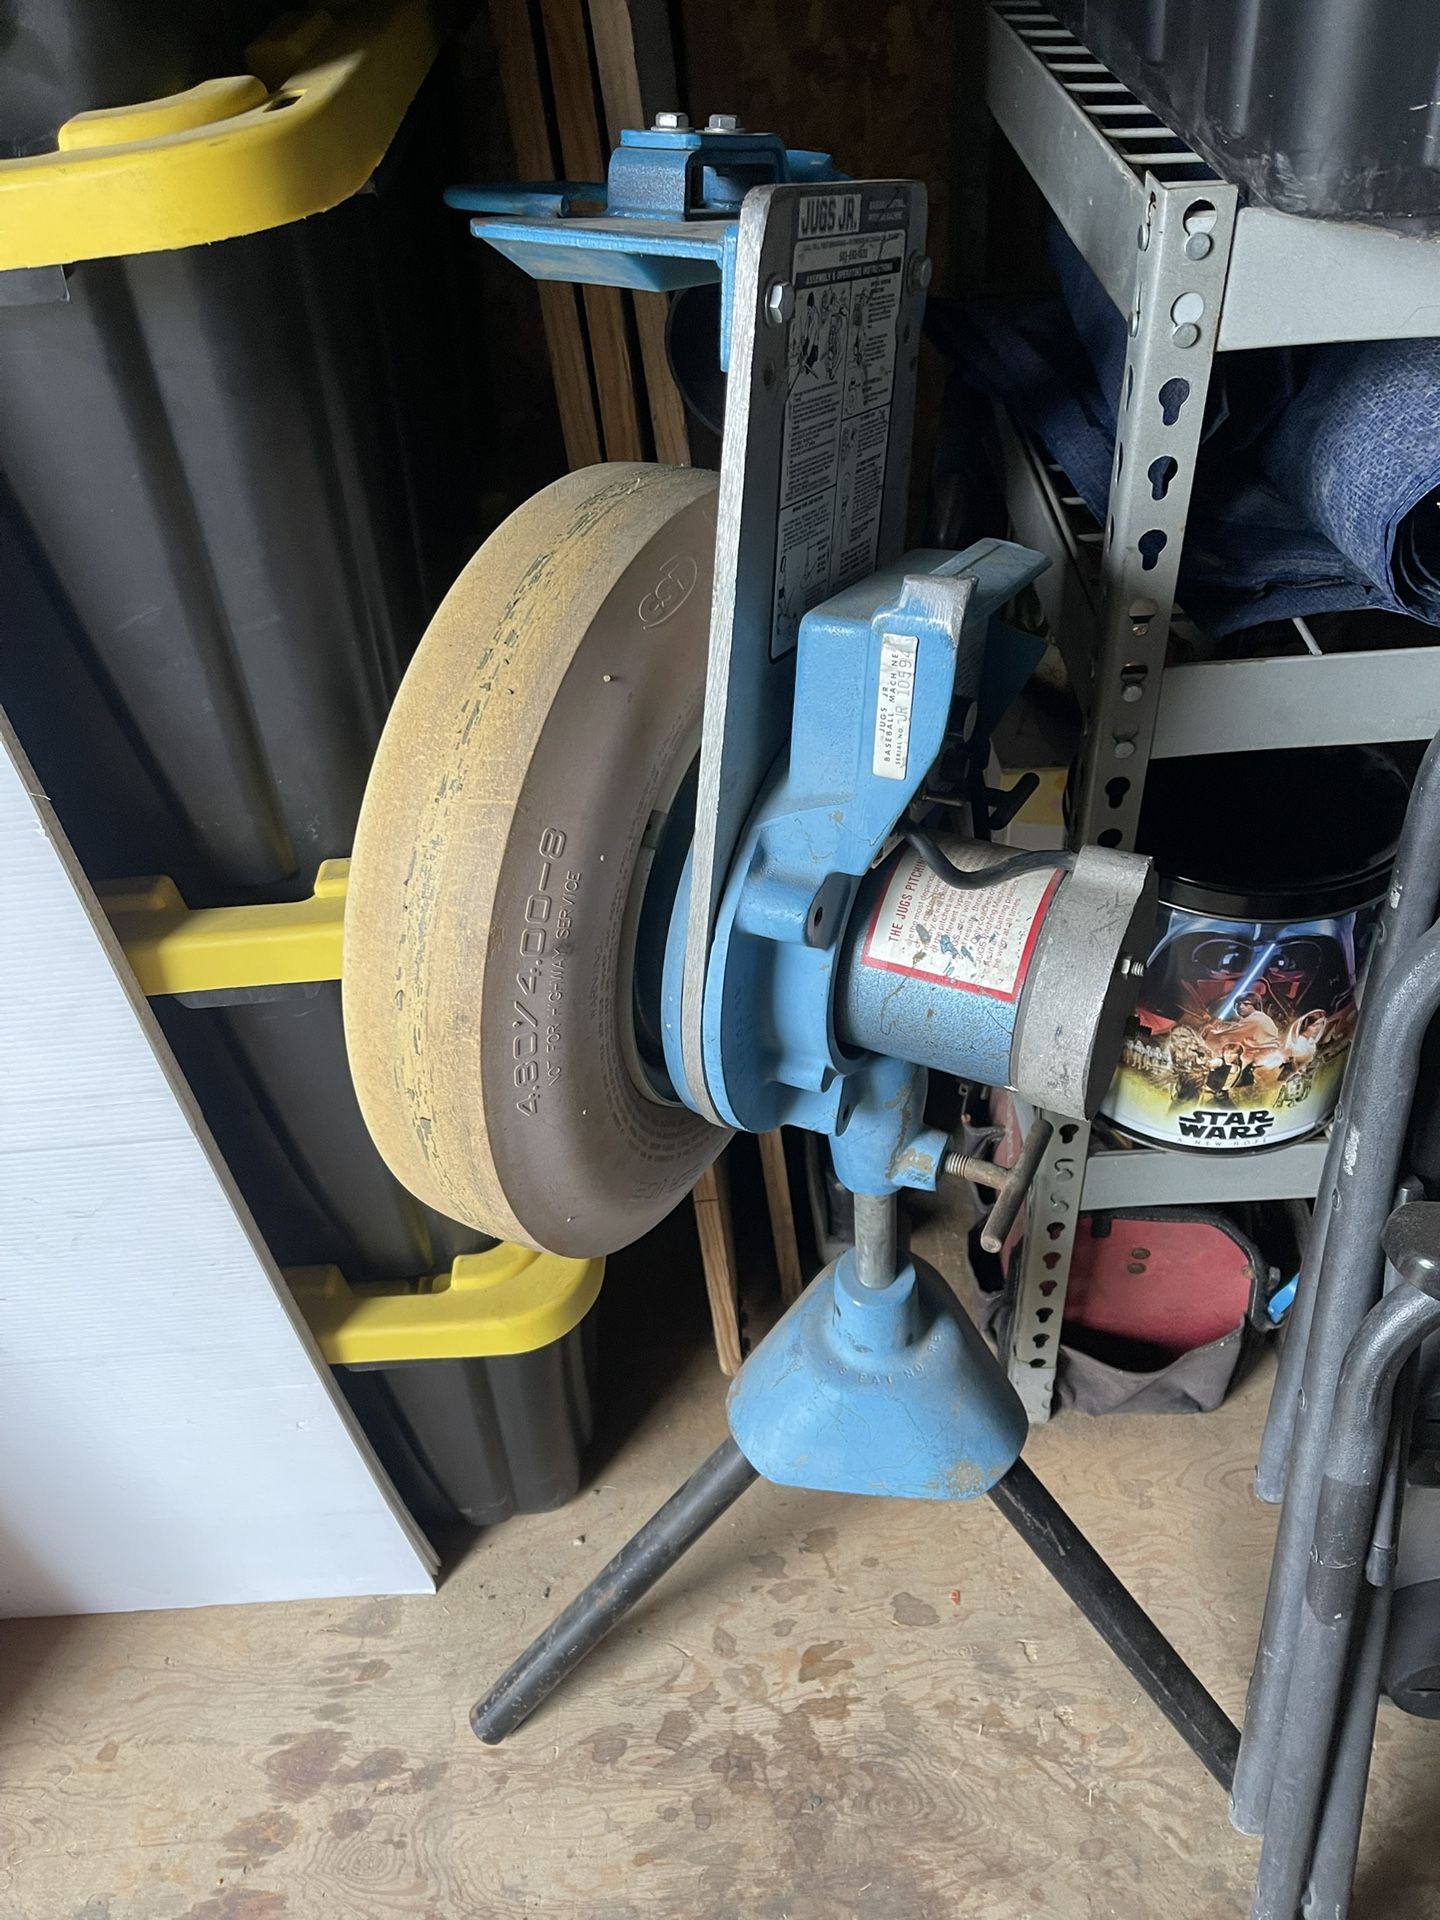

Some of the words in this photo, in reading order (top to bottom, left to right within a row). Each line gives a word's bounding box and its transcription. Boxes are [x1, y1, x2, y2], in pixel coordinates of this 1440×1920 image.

[801, 196, 836, 235] JUGS
[838, 196, 858, 232] JR.
[888, 653, 899, 703] MACHNE
[879, 707, 888, 733] JUGS
[884, 712, 894, 762] BASEBALL
[895, 741, 903, 765] SERIAL
[555, 869, 583, 940] SERVICE
[888, 921, 904, 943] THE
[896, 892, 913, 920] JUGS
[905, 855, 928, 892] PITCHIN
[910, 921, 918, 934] the
[914, 902, 924, 920] most
[921, 873, 936, 900] depend
[948, 889, 957, 903] and
[972, 893, 985, 911] throw
[937, 902, 952, 931] pitches
[978, 895, 993, 925] coaches
[995, 905, 1009, 930] batting
[933, 931, 942, 943] the
[976, 941, 987, 963] JUGS
[547, 947, 569, 1017] HIGHWAY
[546, 1023, 562, 1053] FOR
[546, 1060, 563, 1087] NOT
[1178, 1110, 1275, 1125] STAR
[1178, 1121, 1273, 1139] WARS
[1232, 1138, 1266, 1146] HOPE
